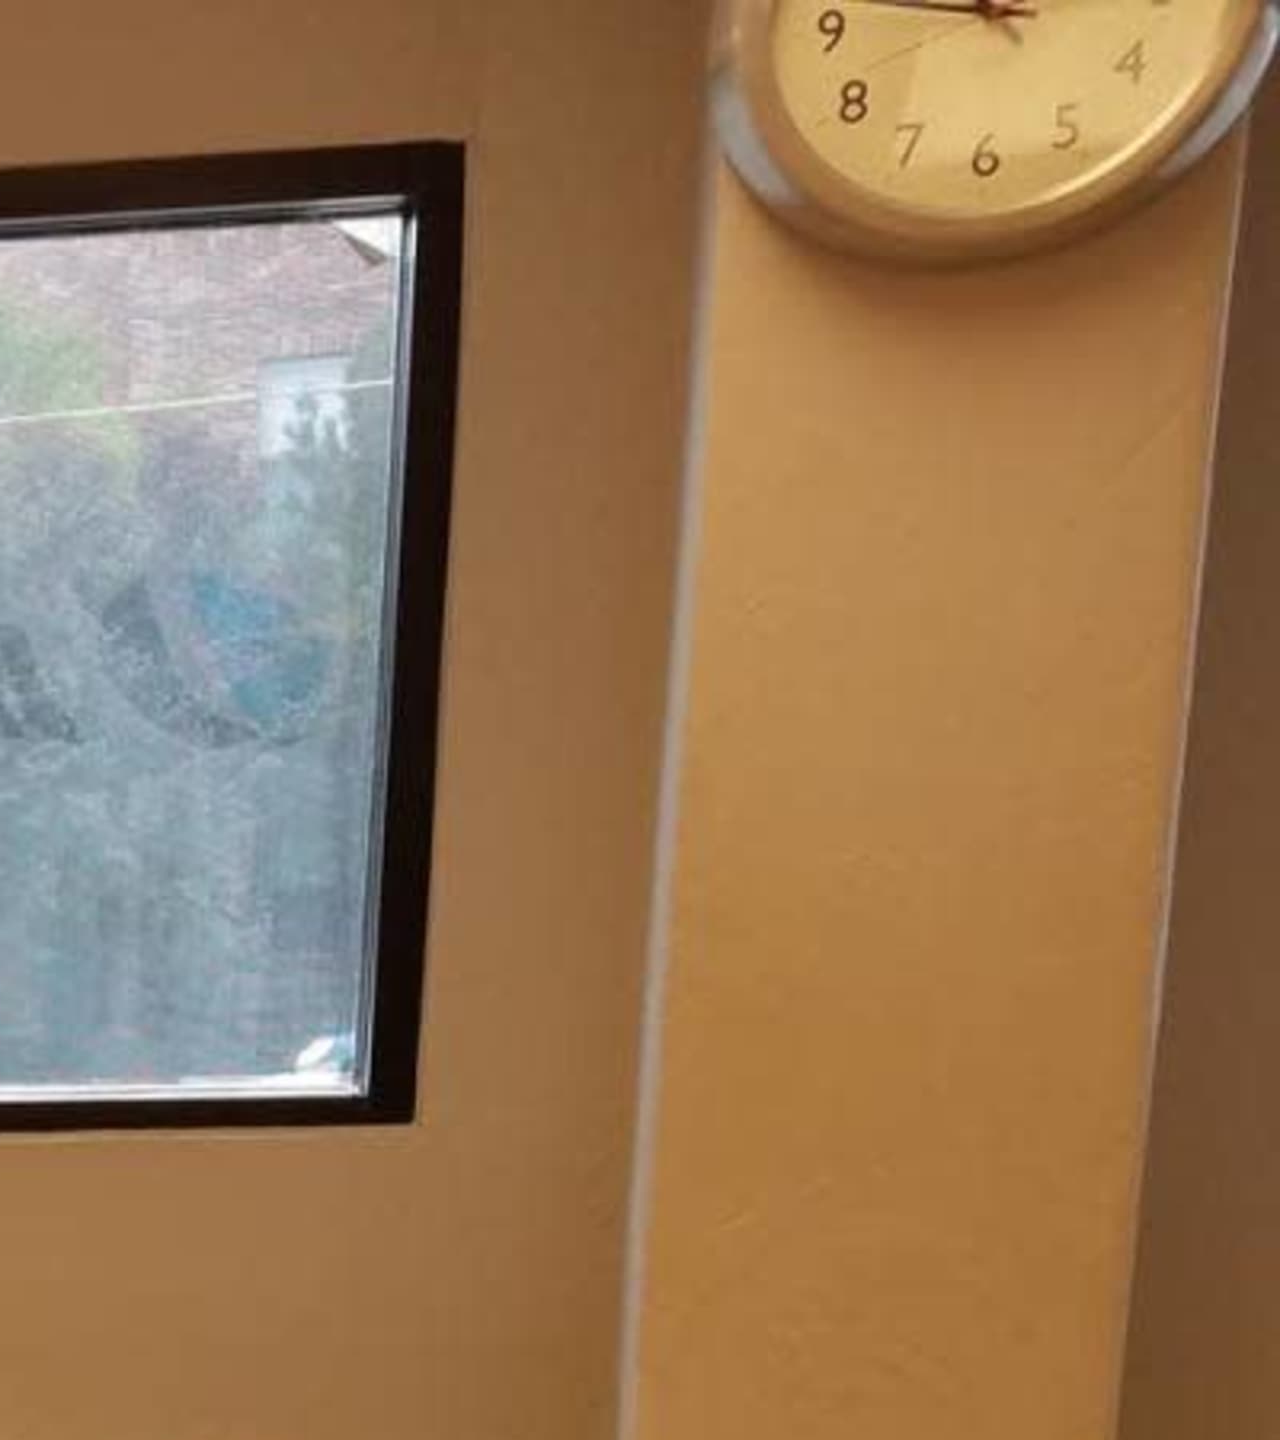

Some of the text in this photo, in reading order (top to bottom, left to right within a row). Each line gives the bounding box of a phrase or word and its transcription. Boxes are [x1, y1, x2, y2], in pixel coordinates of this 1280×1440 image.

[817, 9, 846, 53] 9
[1114, 38, 1147, 83] 4
[839, 79, 868, 124] 8
[896, 123, 924, 170] 7
[1051, 104, 1079, 150] 5
[972, 134, 1000, 177] 6
